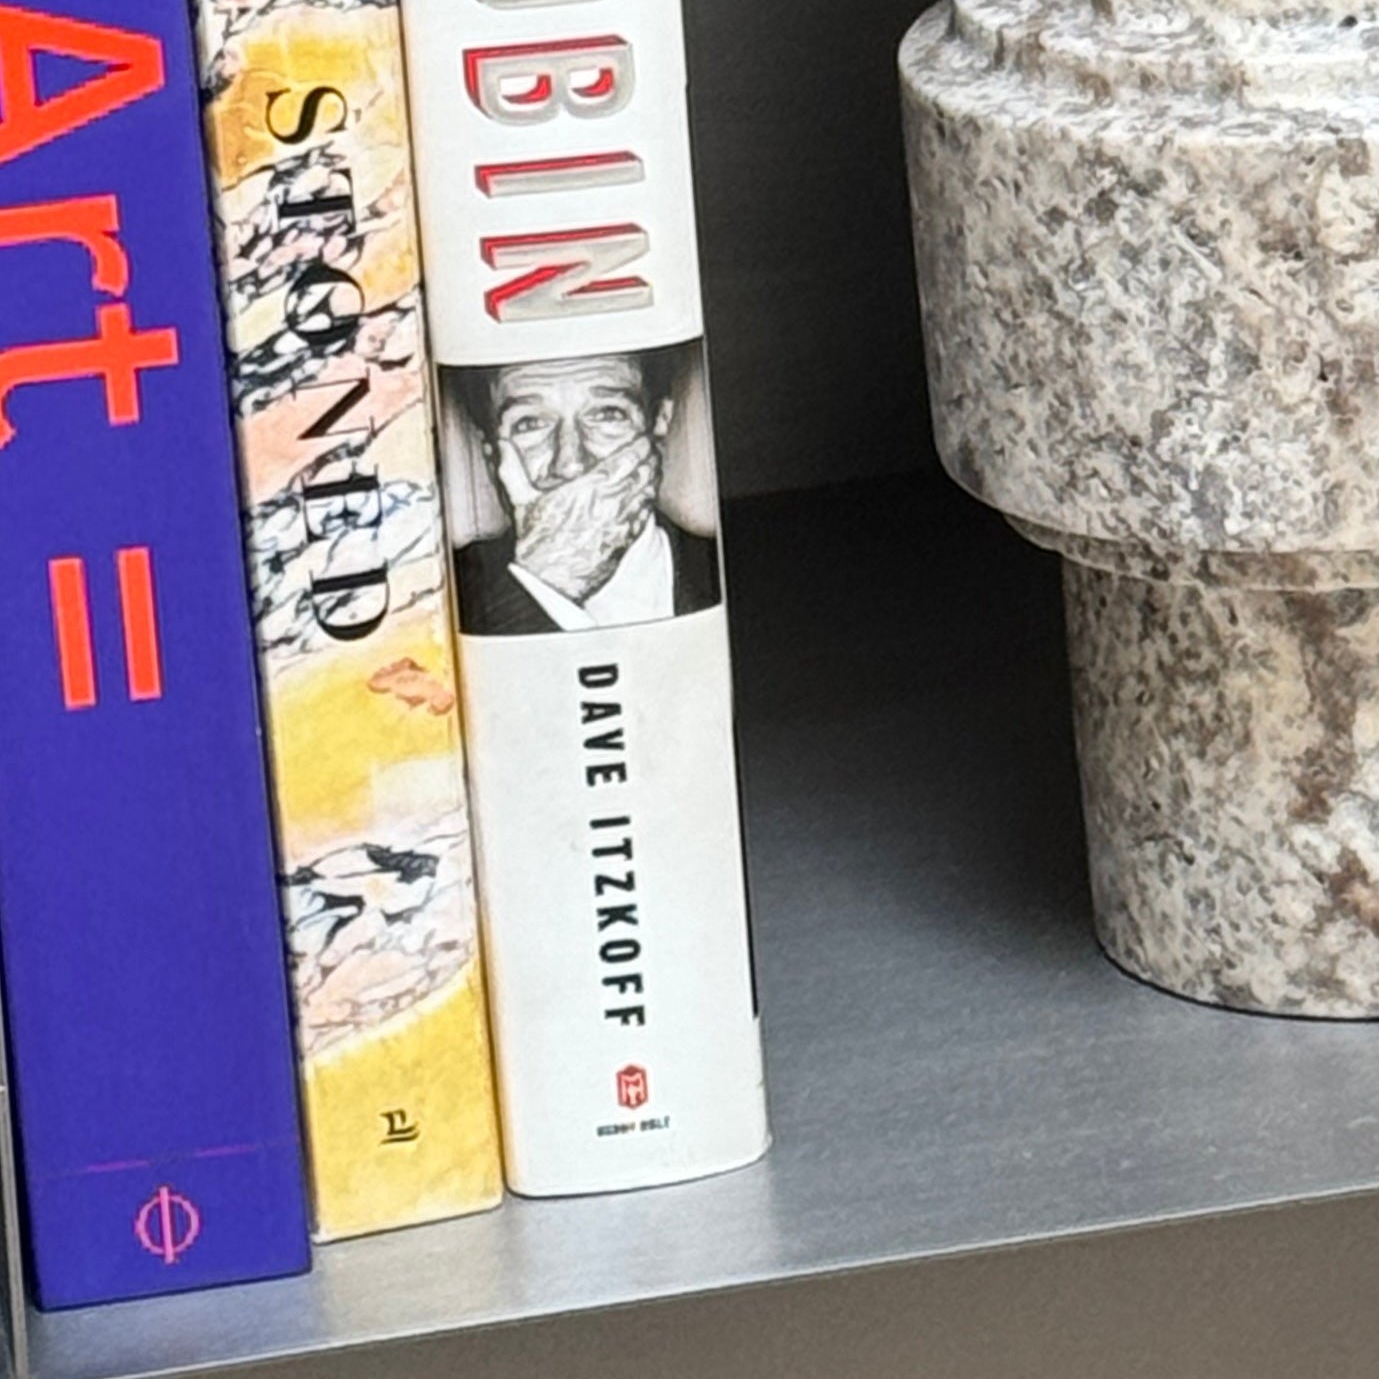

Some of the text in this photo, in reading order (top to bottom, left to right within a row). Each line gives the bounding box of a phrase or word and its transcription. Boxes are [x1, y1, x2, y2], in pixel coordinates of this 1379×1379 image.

[0, 3, 180, 448] Art
[264, 85, 391, 643] STONED
[577, 663, 646, 1028] DAVE ITZKOFF
